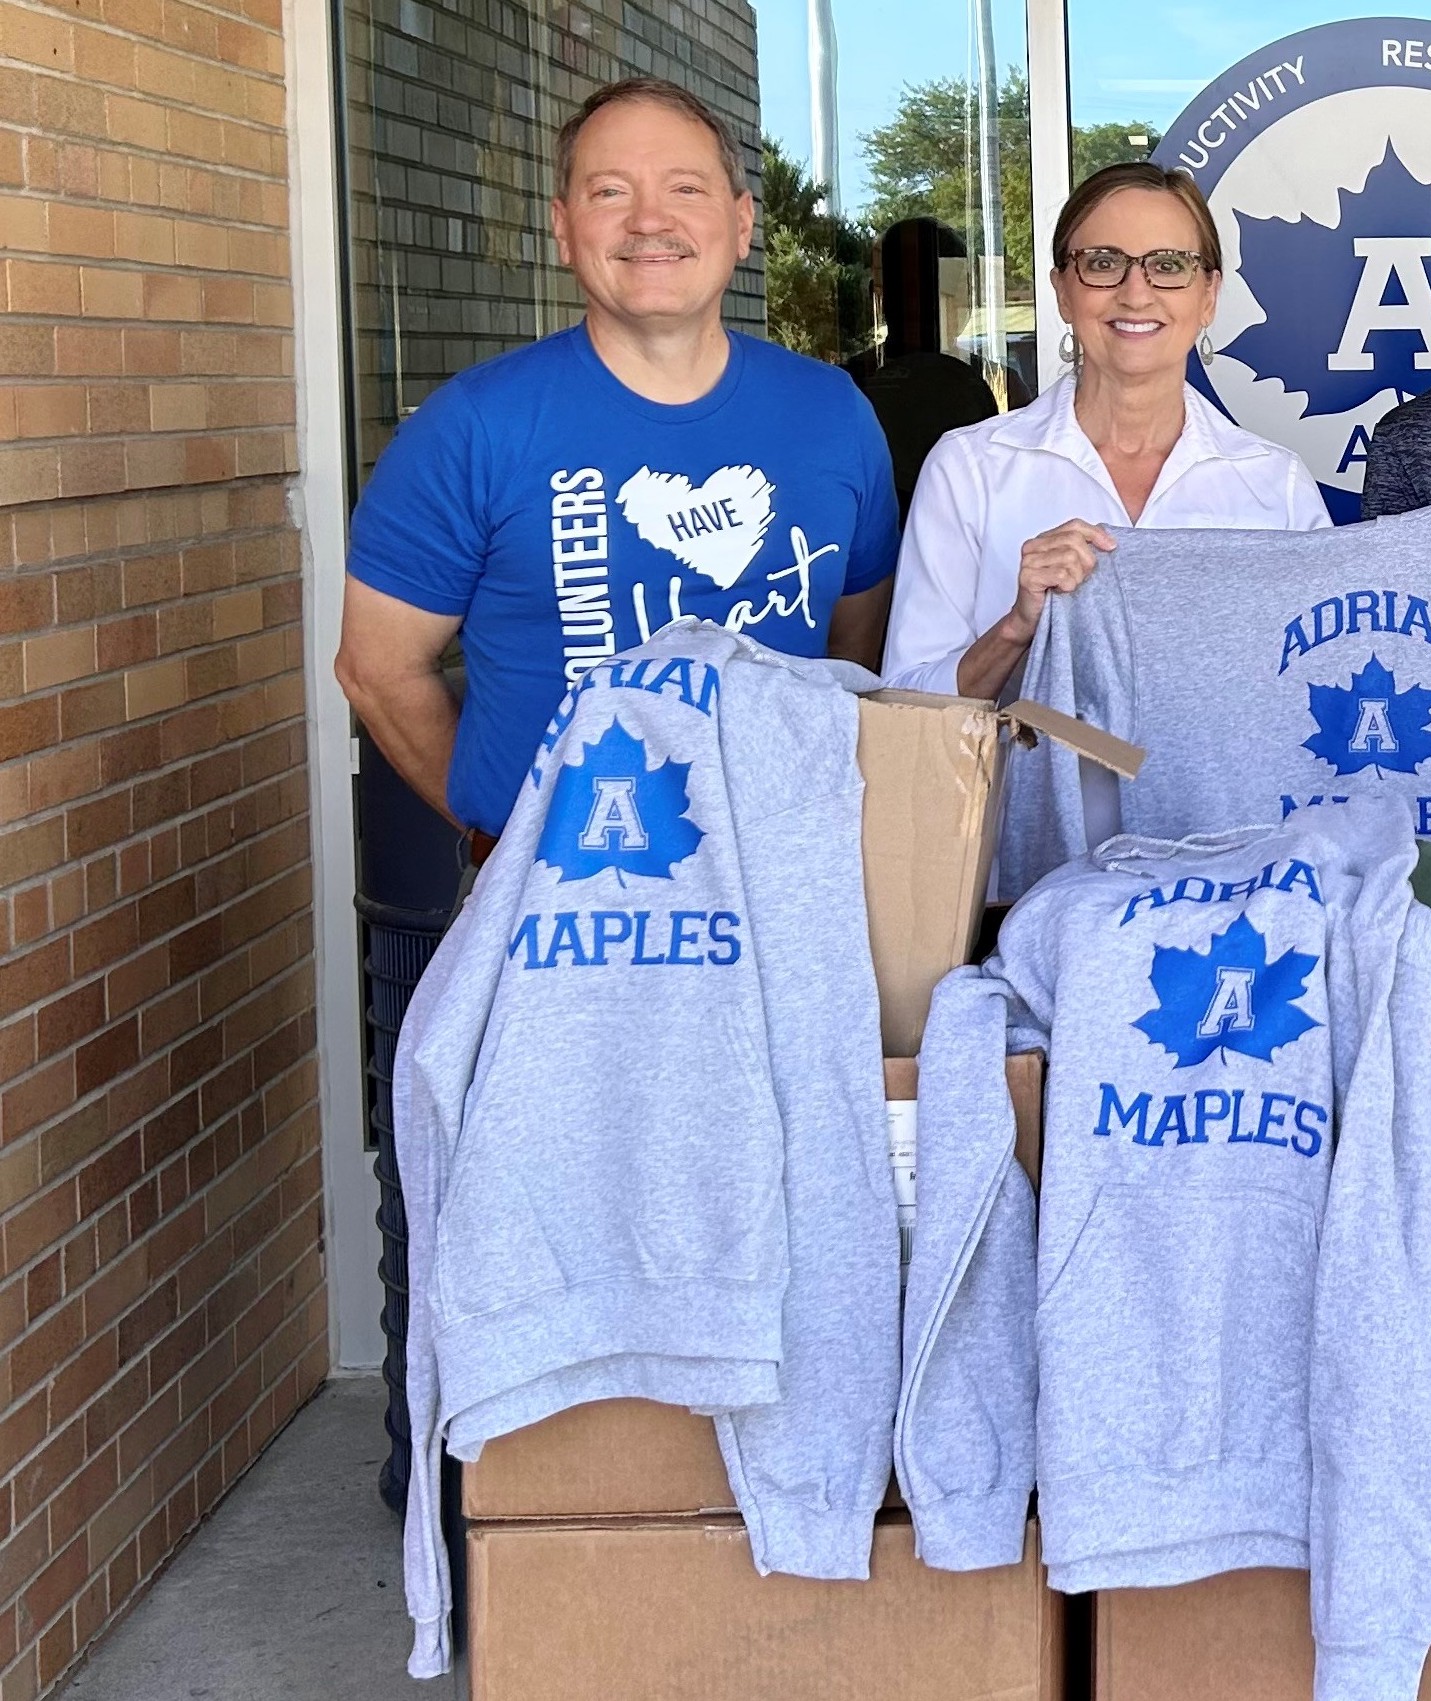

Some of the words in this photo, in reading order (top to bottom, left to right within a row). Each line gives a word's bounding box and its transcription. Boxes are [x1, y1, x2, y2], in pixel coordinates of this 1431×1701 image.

[667, 497, 743, 543] HAVE
[550, 467, 616, 692] OLUNTEERS
[1349, 697, 1400, 753] A
[578, 775, 650, 851] A
[507, 909, 742, 971] MAPLES
[1197, 966, 1256, 1039] A
[1092, 1083, 1328, 1158] MAPLES
